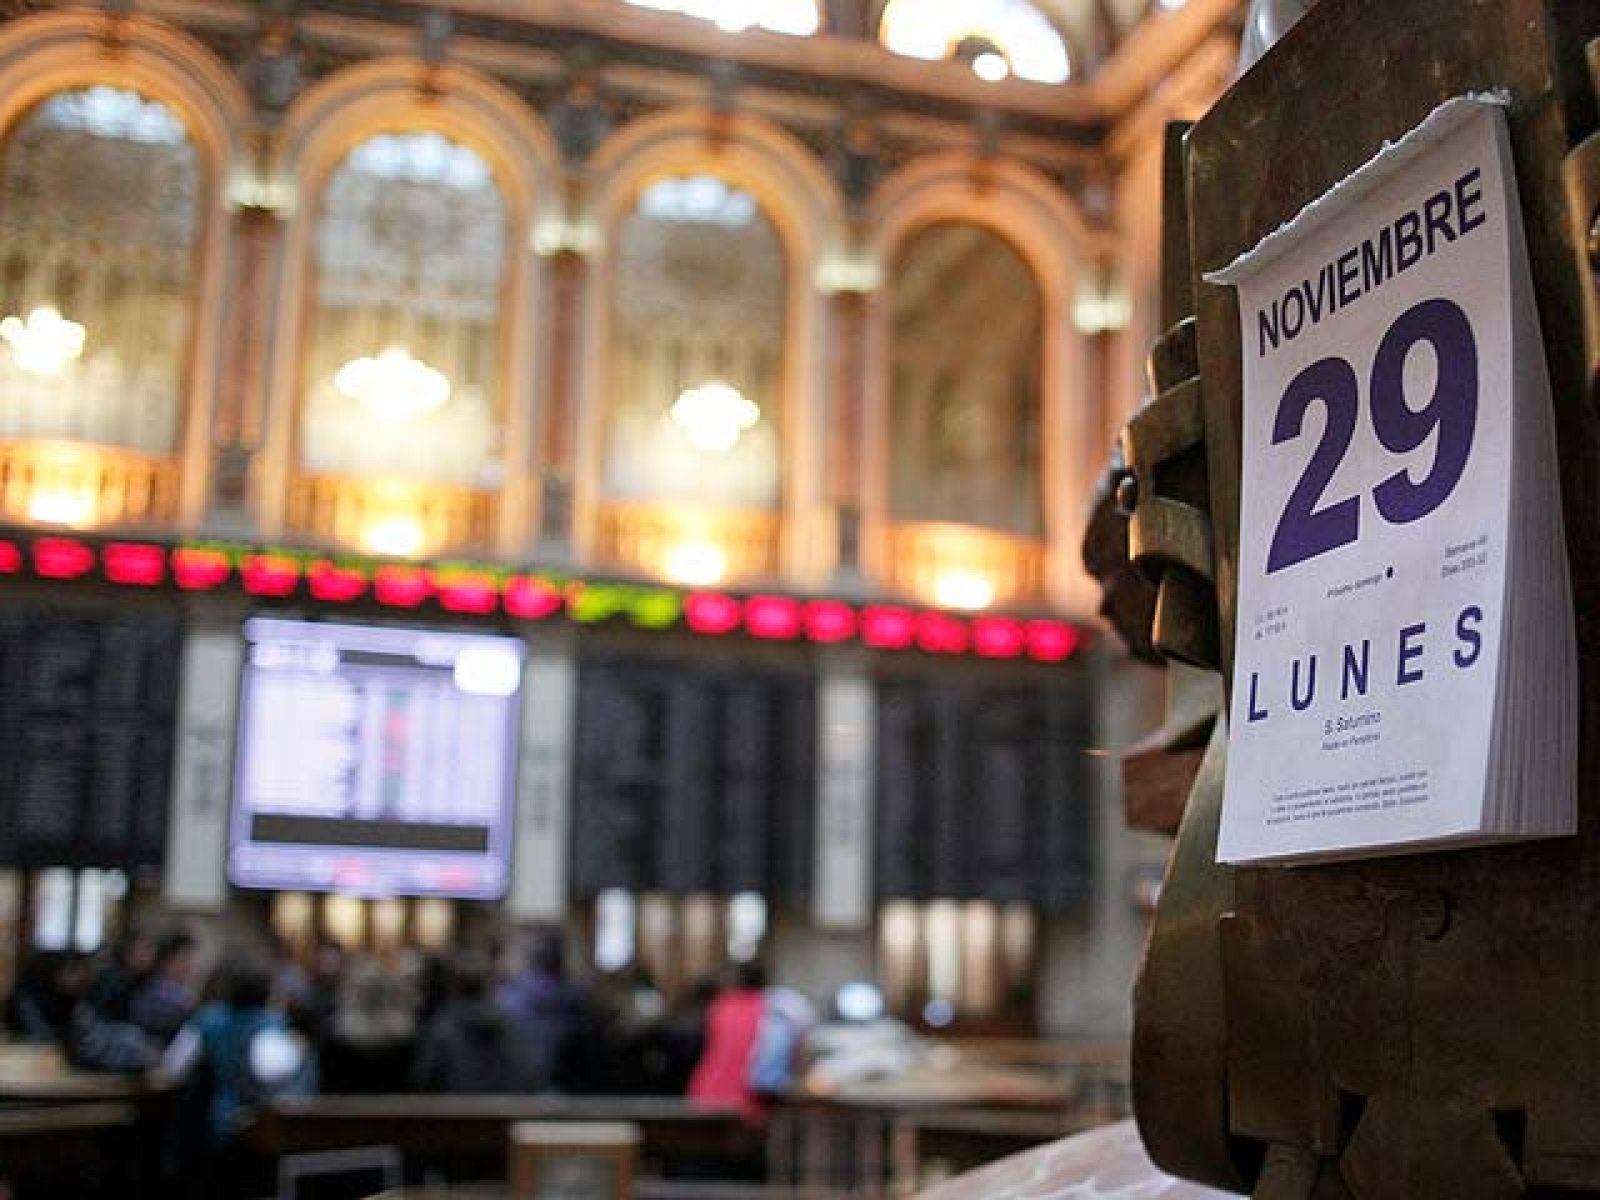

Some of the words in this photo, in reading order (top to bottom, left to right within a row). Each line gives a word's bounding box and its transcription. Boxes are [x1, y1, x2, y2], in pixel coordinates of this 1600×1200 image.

[1258, 167, 1486, 358] NOVIEMBRE
[1266, 297, 1478, 575] 29
[1248, 605, 1482, 723] LUNES
